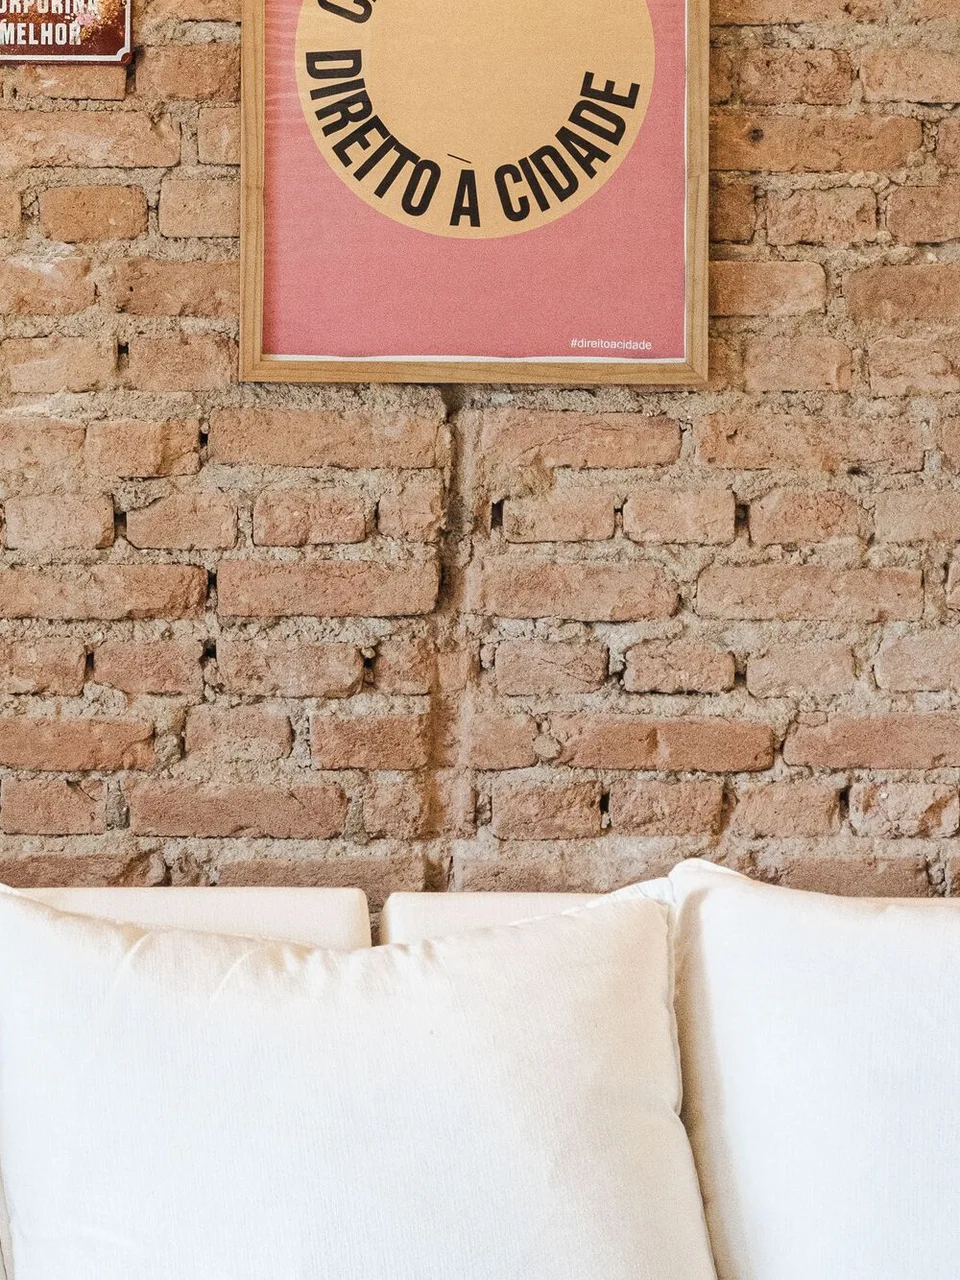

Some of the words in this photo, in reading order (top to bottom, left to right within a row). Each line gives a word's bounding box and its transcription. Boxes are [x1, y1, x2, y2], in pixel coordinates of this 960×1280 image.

[305, 49, 442, 219] DIREITO
[494, 71, 641, 223] CIDADE
[570, 337, 652, 352] #direitoacidade
